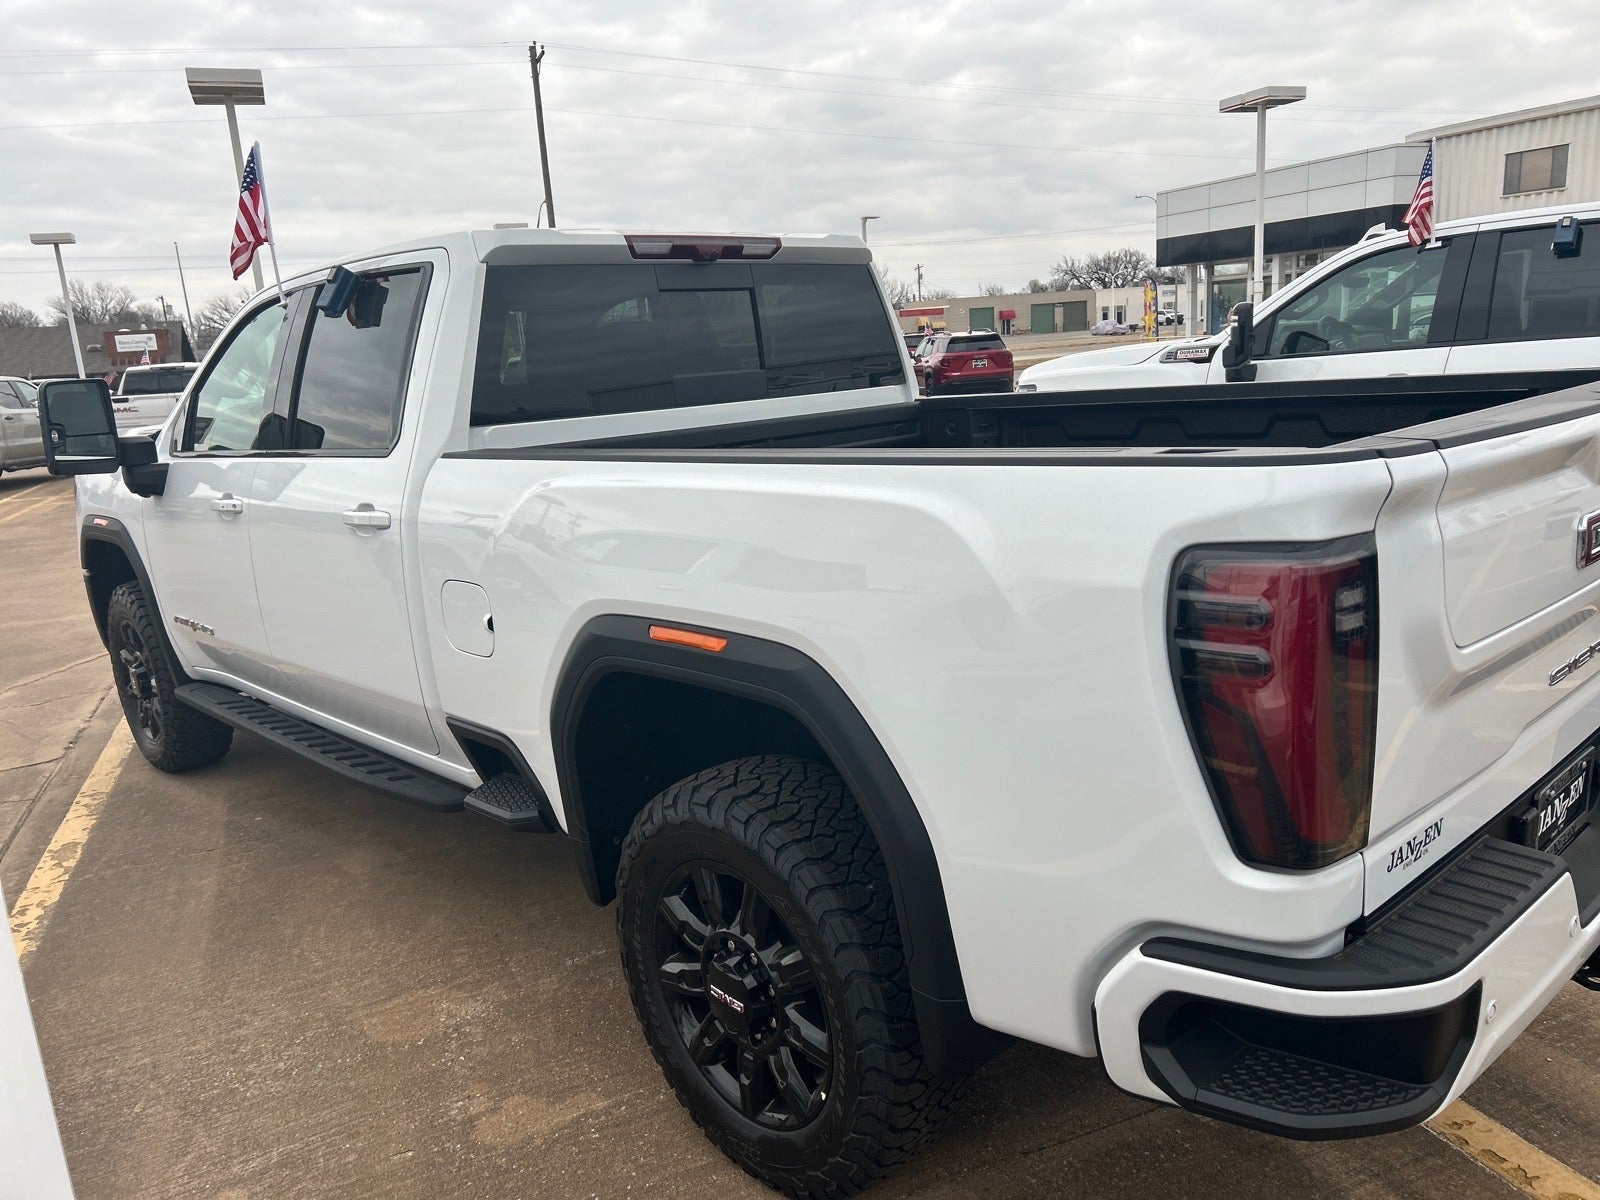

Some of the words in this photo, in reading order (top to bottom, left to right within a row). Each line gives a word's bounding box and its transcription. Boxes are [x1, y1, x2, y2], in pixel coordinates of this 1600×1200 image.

[1538, 771, 1586, 836] JANZEN
[1386, 816, 1444, 873] JANZEN
[710, 984, 744, 1013] GMC
